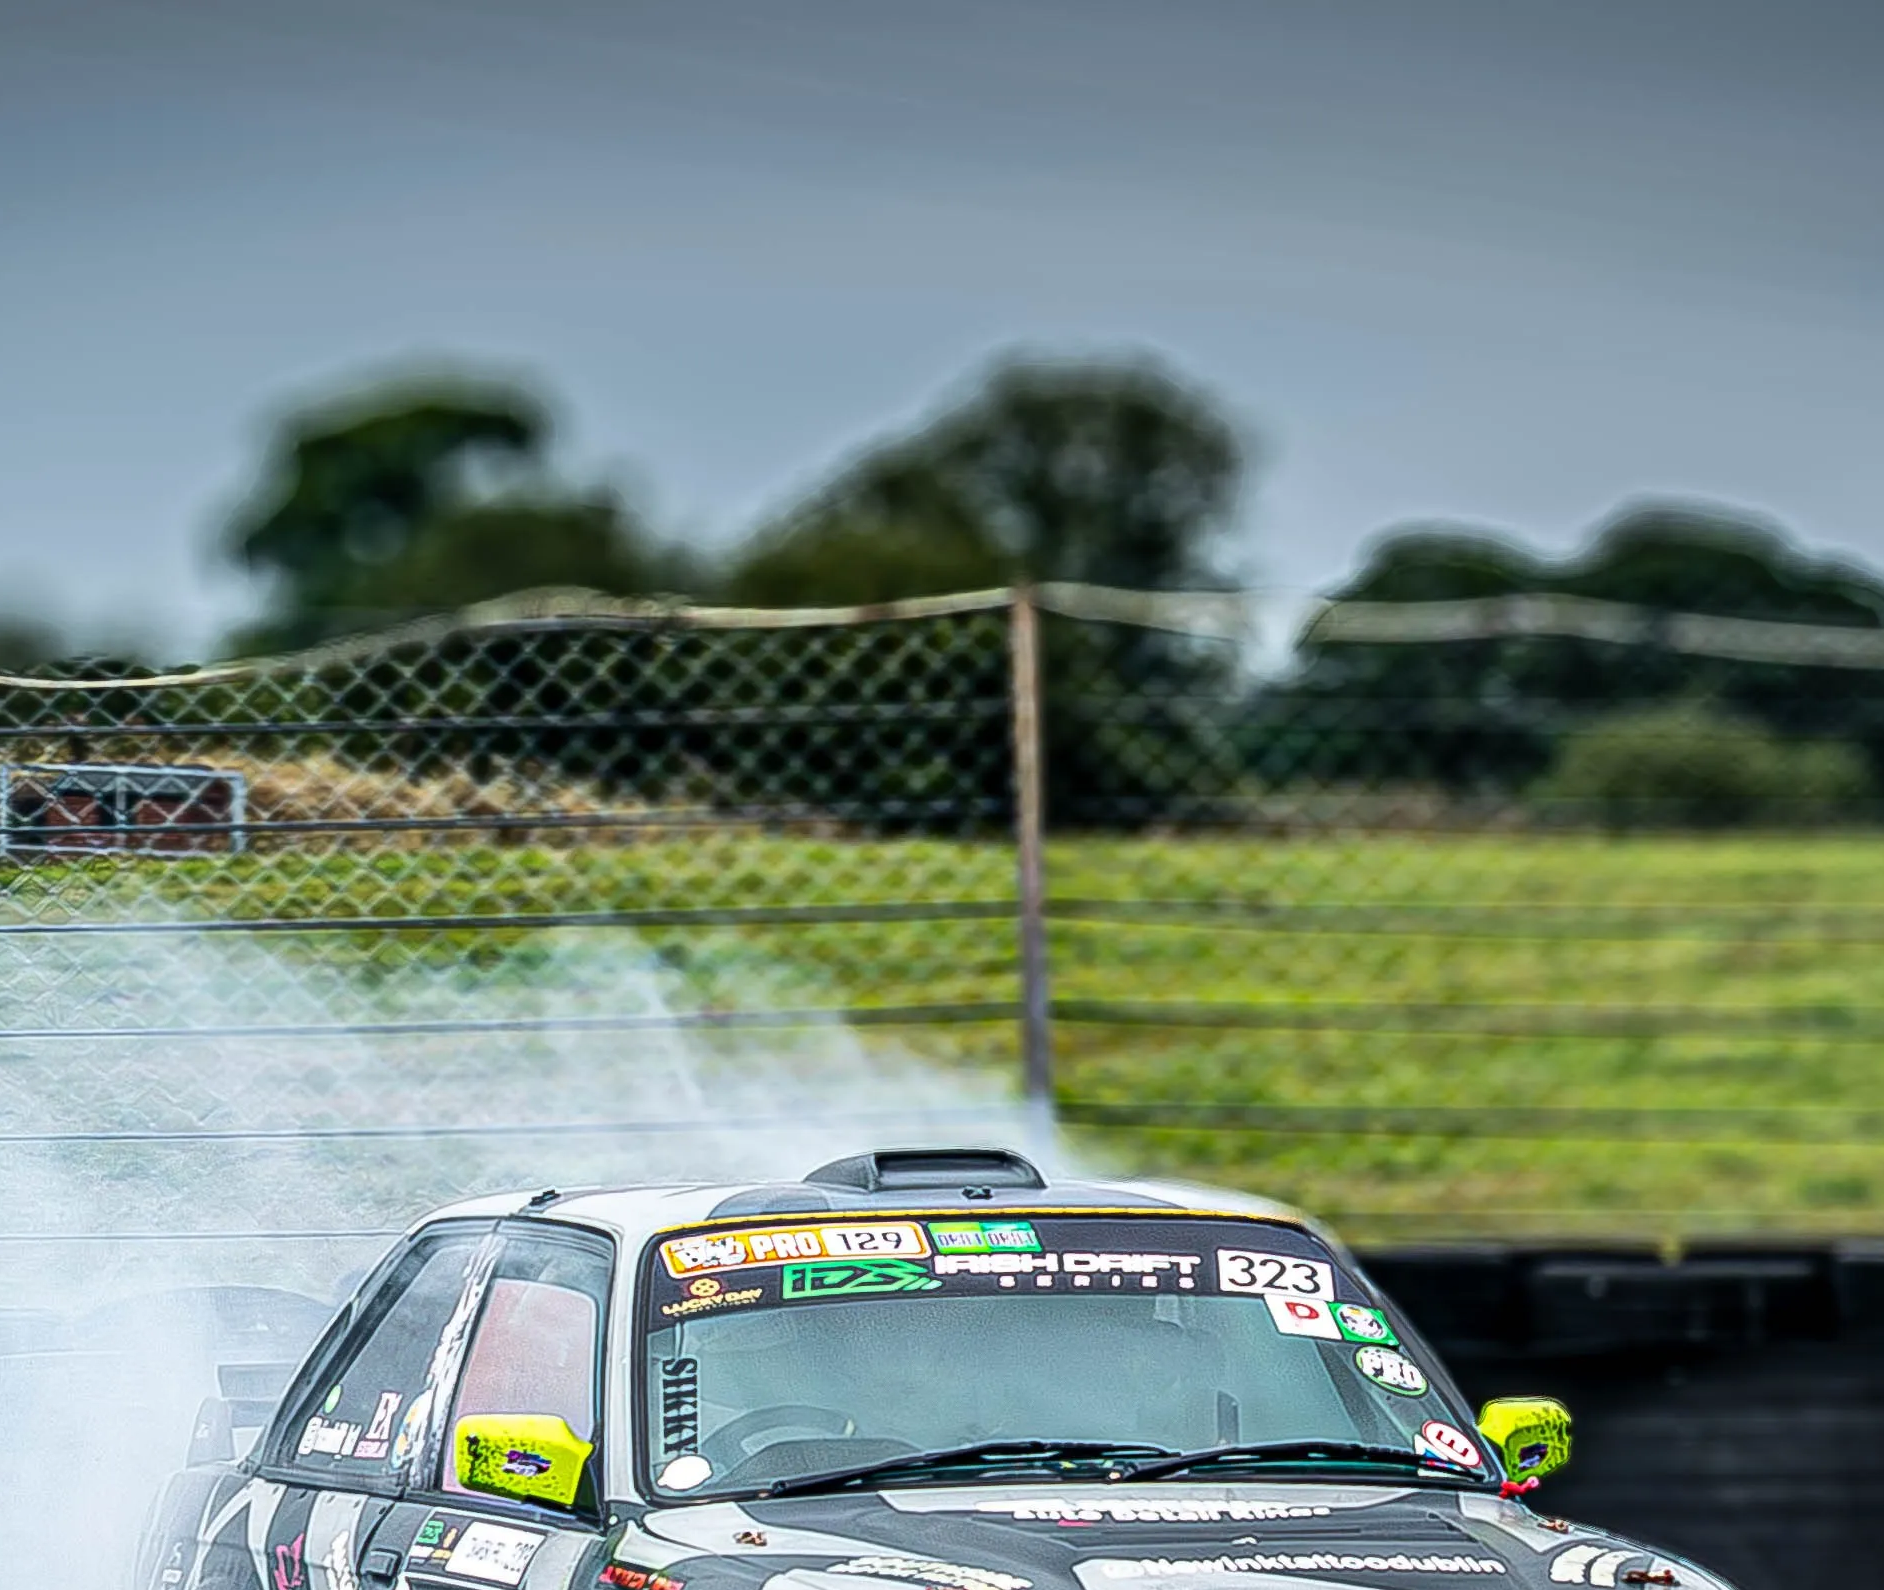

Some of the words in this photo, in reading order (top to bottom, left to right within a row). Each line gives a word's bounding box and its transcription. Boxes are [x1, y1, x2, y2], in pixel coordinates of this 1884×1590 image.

[749, 1232, 820, 1259] PRO
[836, 1231, 903, 1251] 129
[934, 1253, 1059, 1274] IRISH
[1064, 1253, 1201, 1274] DRIFT
[1228, 1255, 1321, 1294] 323
[662, 1358, 698, 1455] SIKKY
